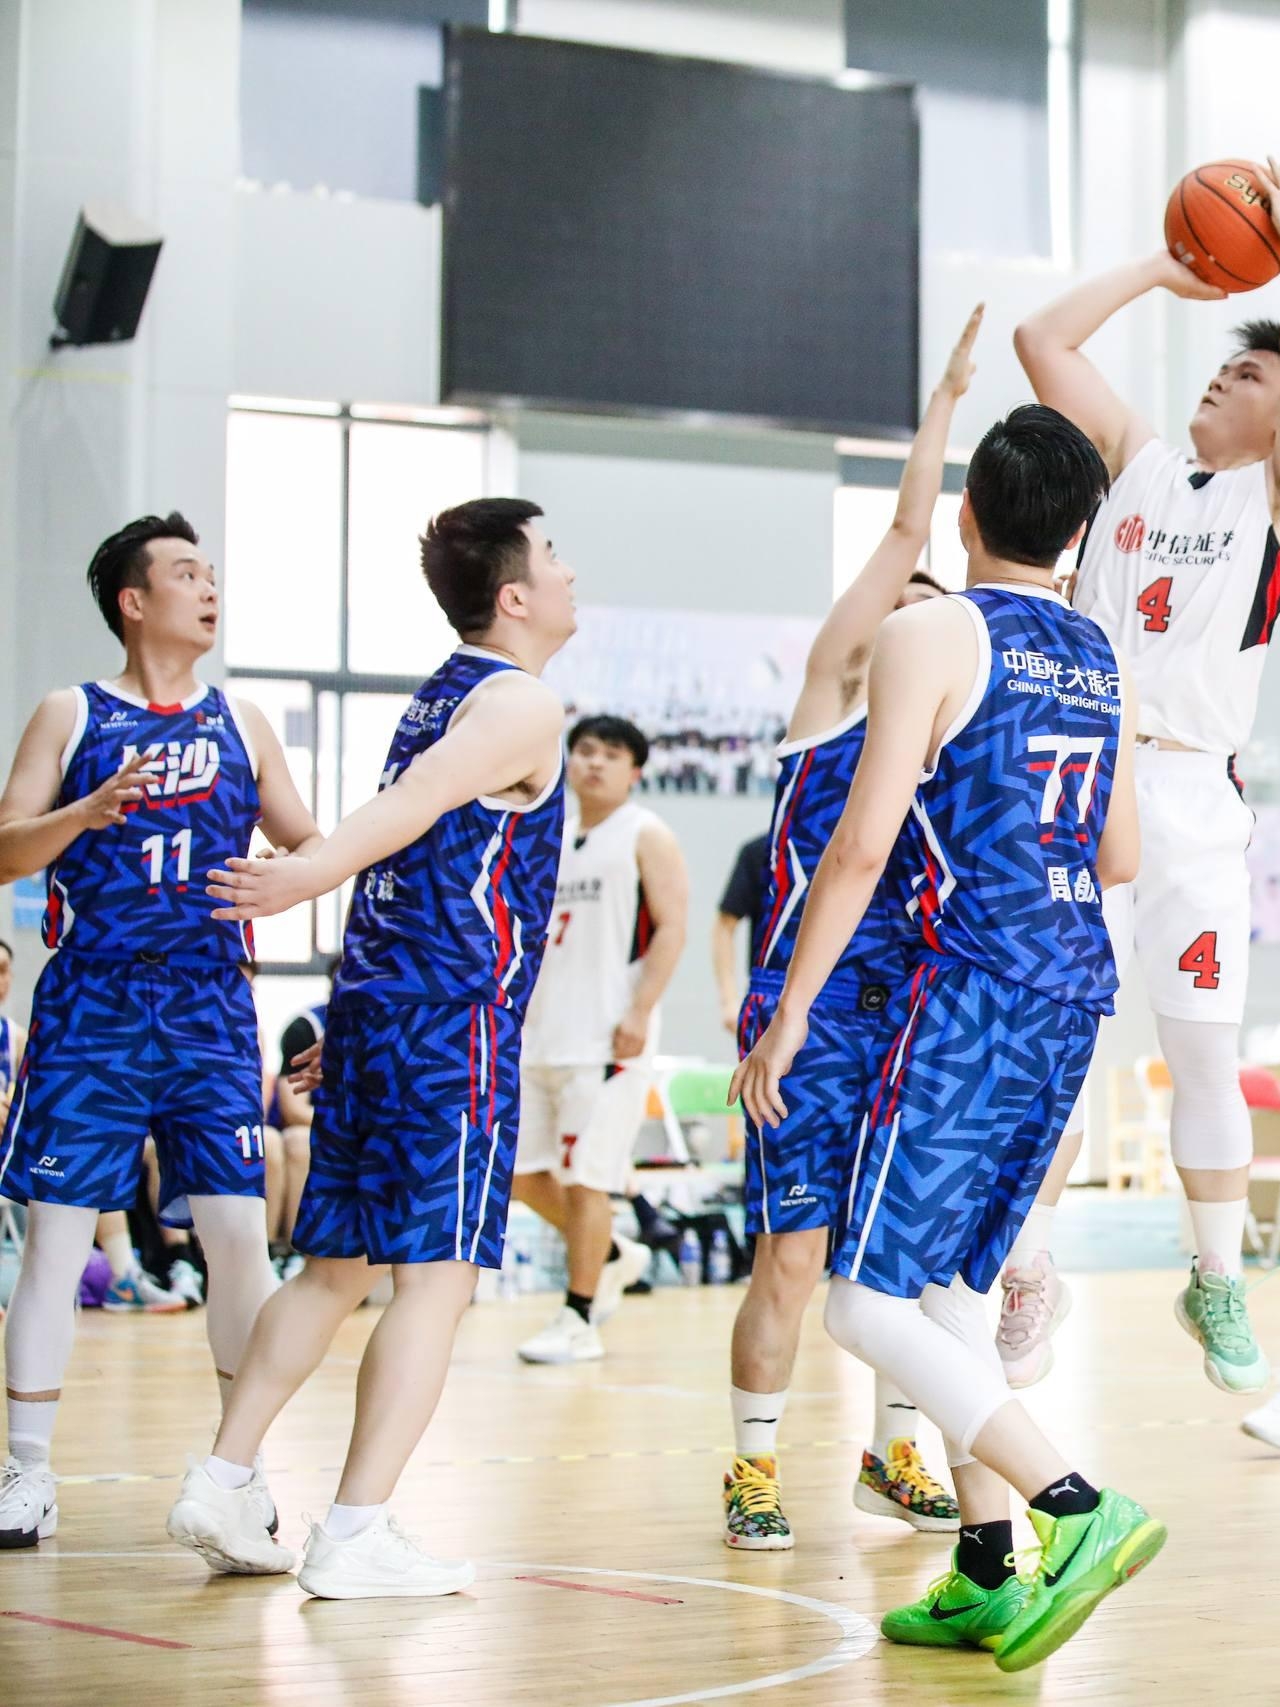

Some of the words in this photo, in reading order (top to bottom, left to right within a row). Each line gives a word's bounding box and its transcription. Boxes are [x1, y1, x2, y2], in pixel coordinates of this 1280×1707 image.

[1136, 576, 1174, 633] 4
[1002, 647, 1121, 700] 中国光大银行
[1007, 679, 1043, 696] CHINA
[1043, 685, 1100, 712] EVRBRIGHT
[1027, 734, 1106, 825] 77
[141, 828, 193, 884] 11
[555, 911, 572, 947] 7
[1178, 930, 1221, 990] 4
[234, 1124, 265, 1158] 11
[560, 1132, 578, 1169] 7
